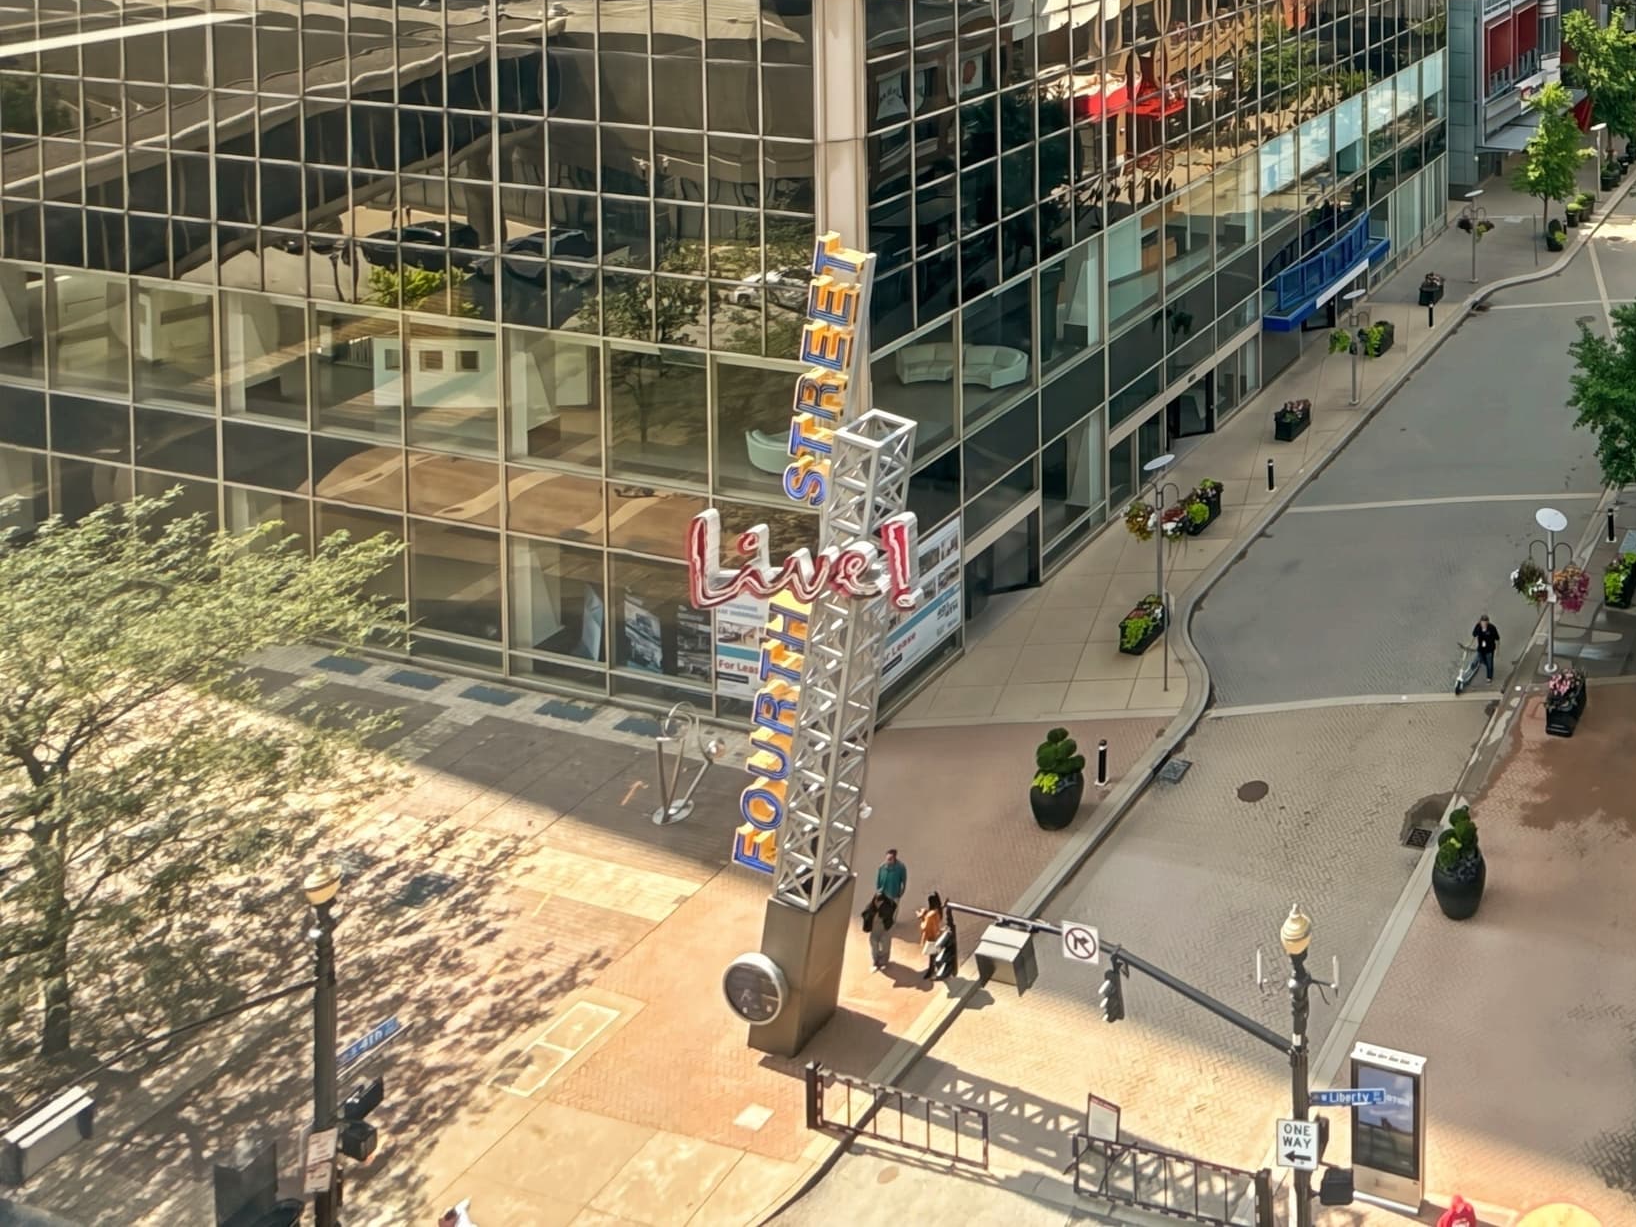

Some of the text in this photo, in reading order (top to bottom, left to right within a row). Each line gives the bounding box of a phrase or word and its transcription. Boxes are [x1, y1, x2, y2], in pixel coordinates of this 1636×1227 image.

[733, 590, 810, 871] FOURTH
[784, 231, 866, 505] STREET
[686, 508, 919, 610] Live!
[891, 633, 916, 658] Lease
[719, 660, 759, 674] For Leas
[1330, 1092, 1369, 1103] Liberty
[1284, 1123, 1311, 1136] ONE
[1283, 1136, 1312, 1149] WAY
